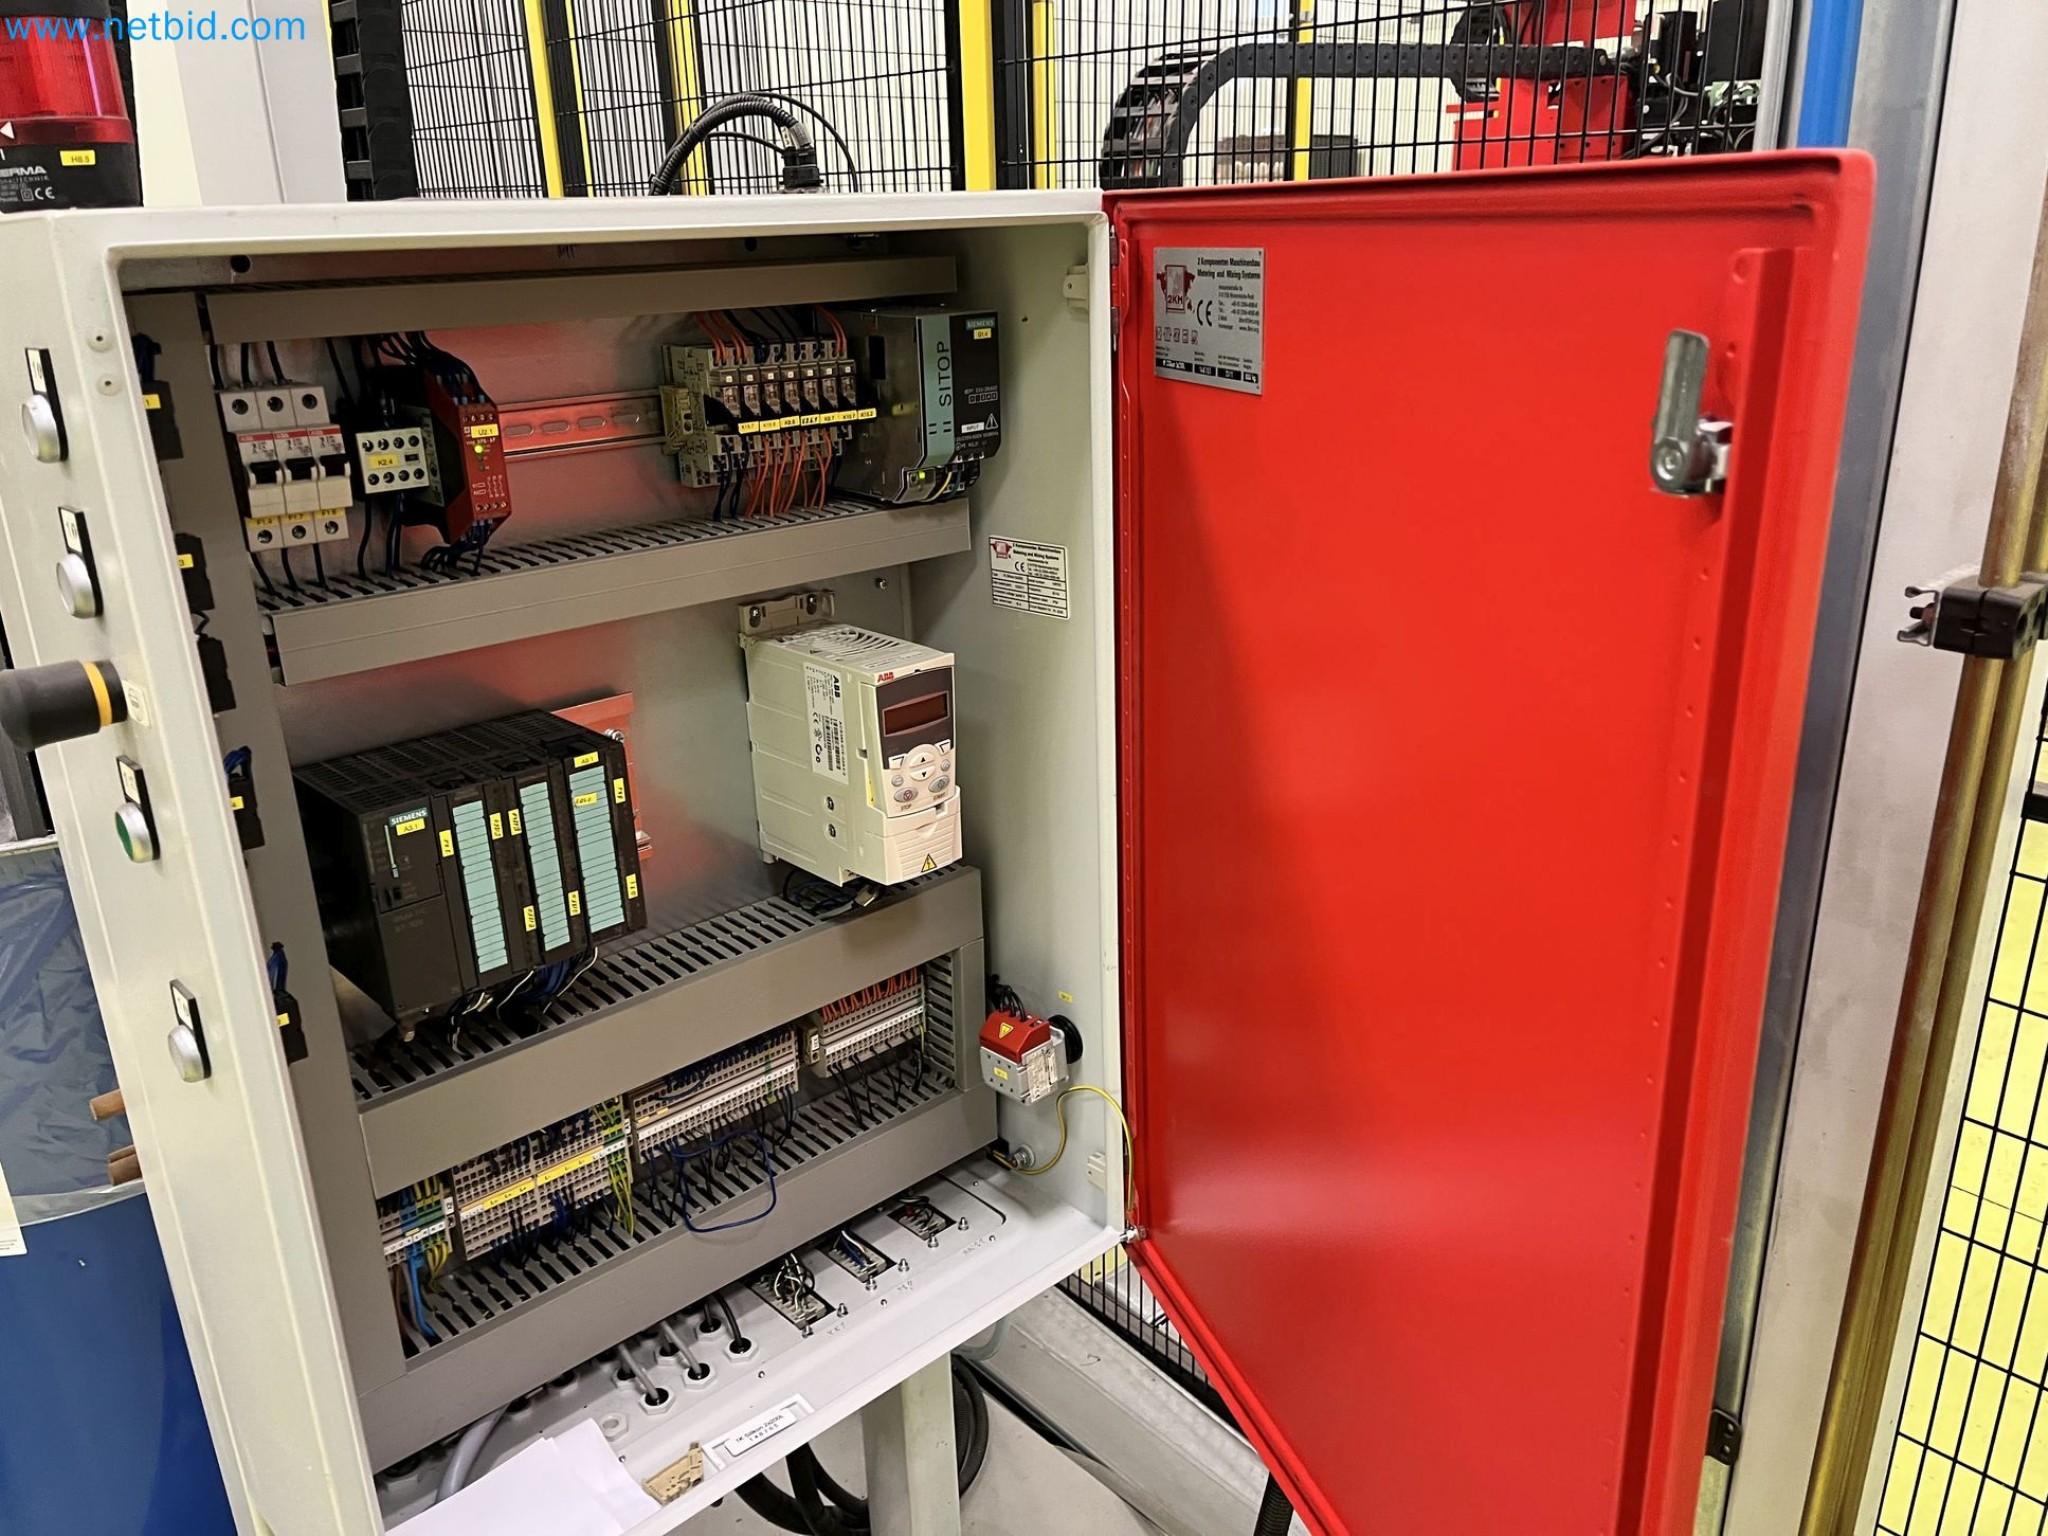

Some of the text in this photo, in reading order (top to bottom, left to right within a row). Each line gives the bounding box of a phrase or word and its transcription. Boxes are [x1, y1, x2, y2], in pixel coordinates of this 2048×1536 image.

[937, 341, 952, 407] SITOP
[877, 671, 894, 682] ABB
[832, 675, 841, 698] ABB
[901, 803, 912, 811] STOP
[391, 809, 428, 824] SIEMENS
